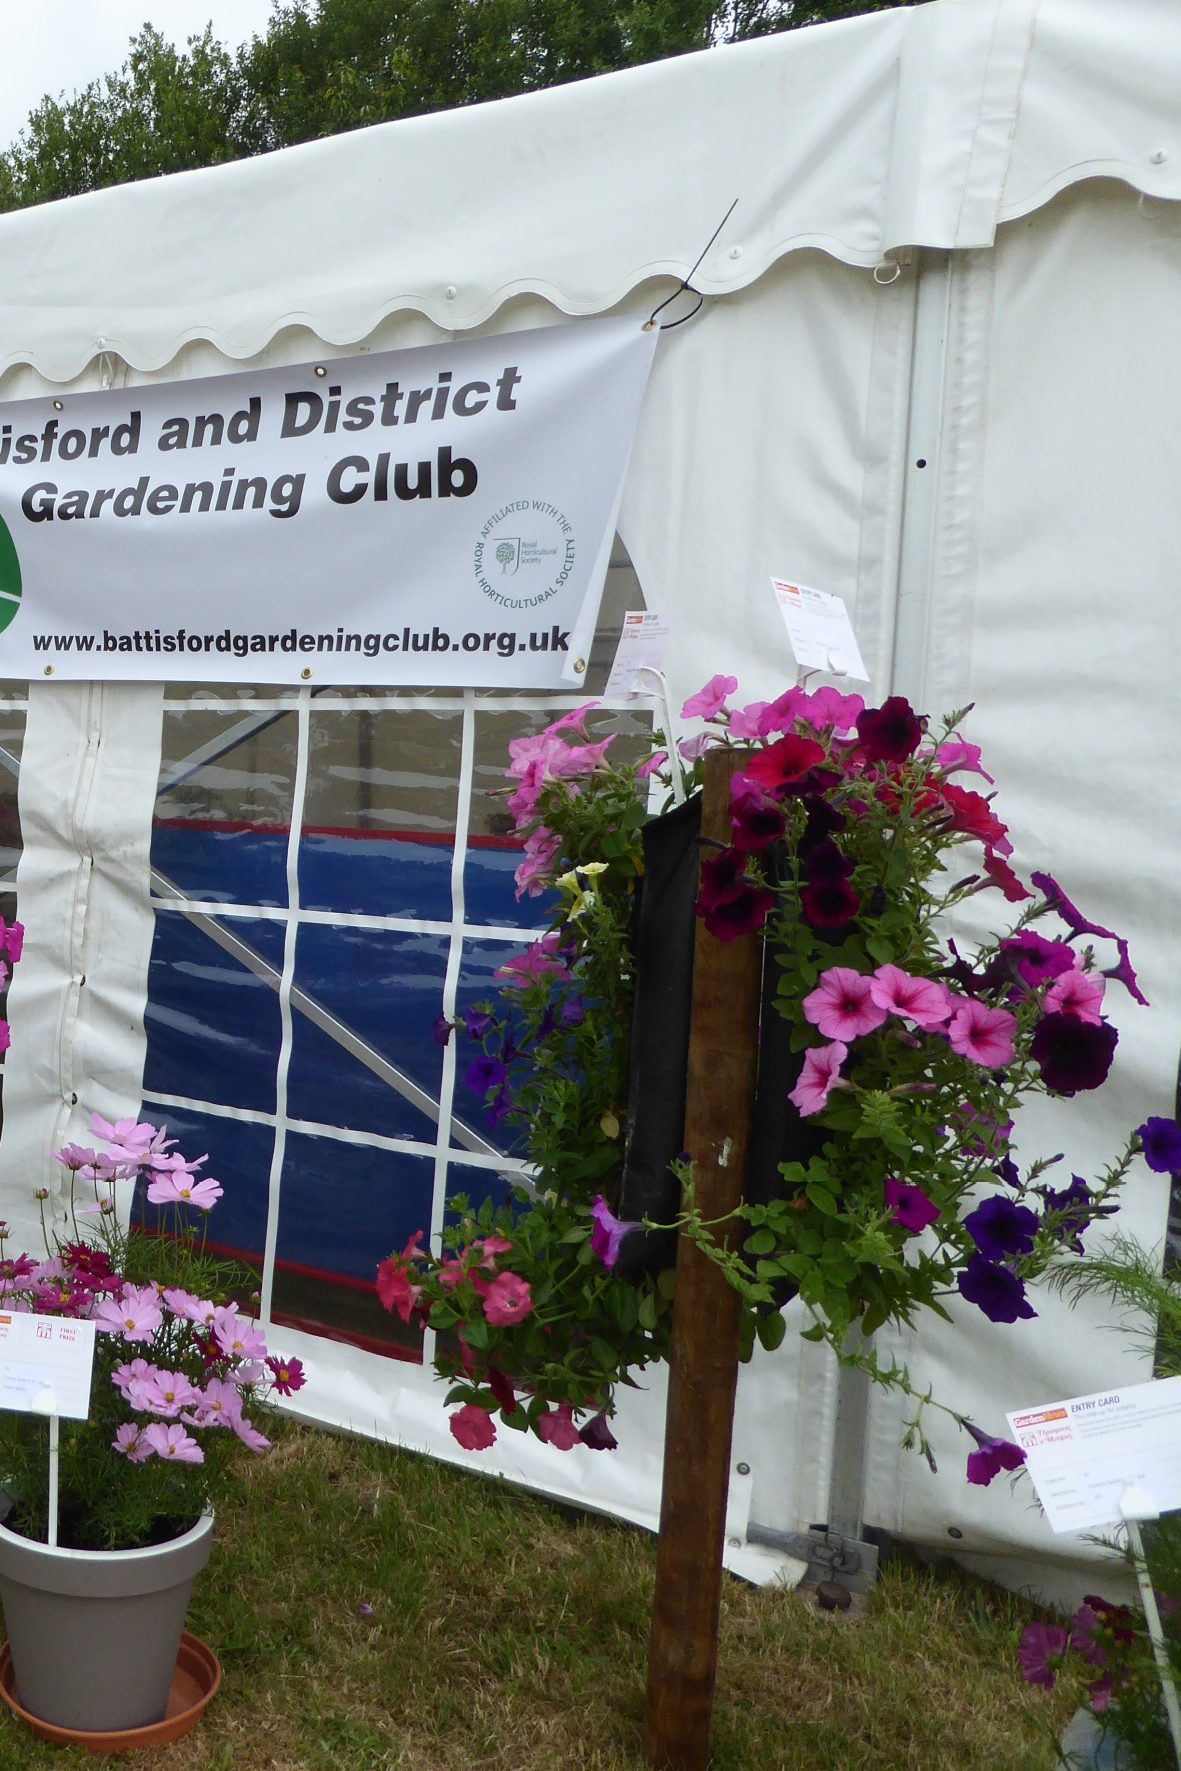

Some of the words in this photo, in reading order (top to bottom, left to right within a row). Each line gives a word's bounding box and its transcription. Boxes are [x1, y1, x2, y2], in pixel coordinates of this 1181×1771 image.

[157, 397, 262, 452] and
[280, 366, 522, 439] District
[21, 467, 306, 523] Gardening
[326, 446, 478, 505] Club
[480, 500, 529, 539] AFFILIATED
[532, 500, 558, 518] WITH
[557, 513, 572, 535] THE
[474, 542, 484, 577] ROYAL
[521, 548, 557, 556] Horticultural
[521, 556, 541, 564] Society
[522, 541, 537, 549] Royal
[555, 538, 575, 587] SOCIETY
[478, 577, 558, 609] HORTICULTURAL
[33, 625, 571, 658] www.battisfordgardeningclub.org.uk
[1071, 1400, 1096, 1413] ENTRY
[1098, 1395, 1120, 1407] CARD
